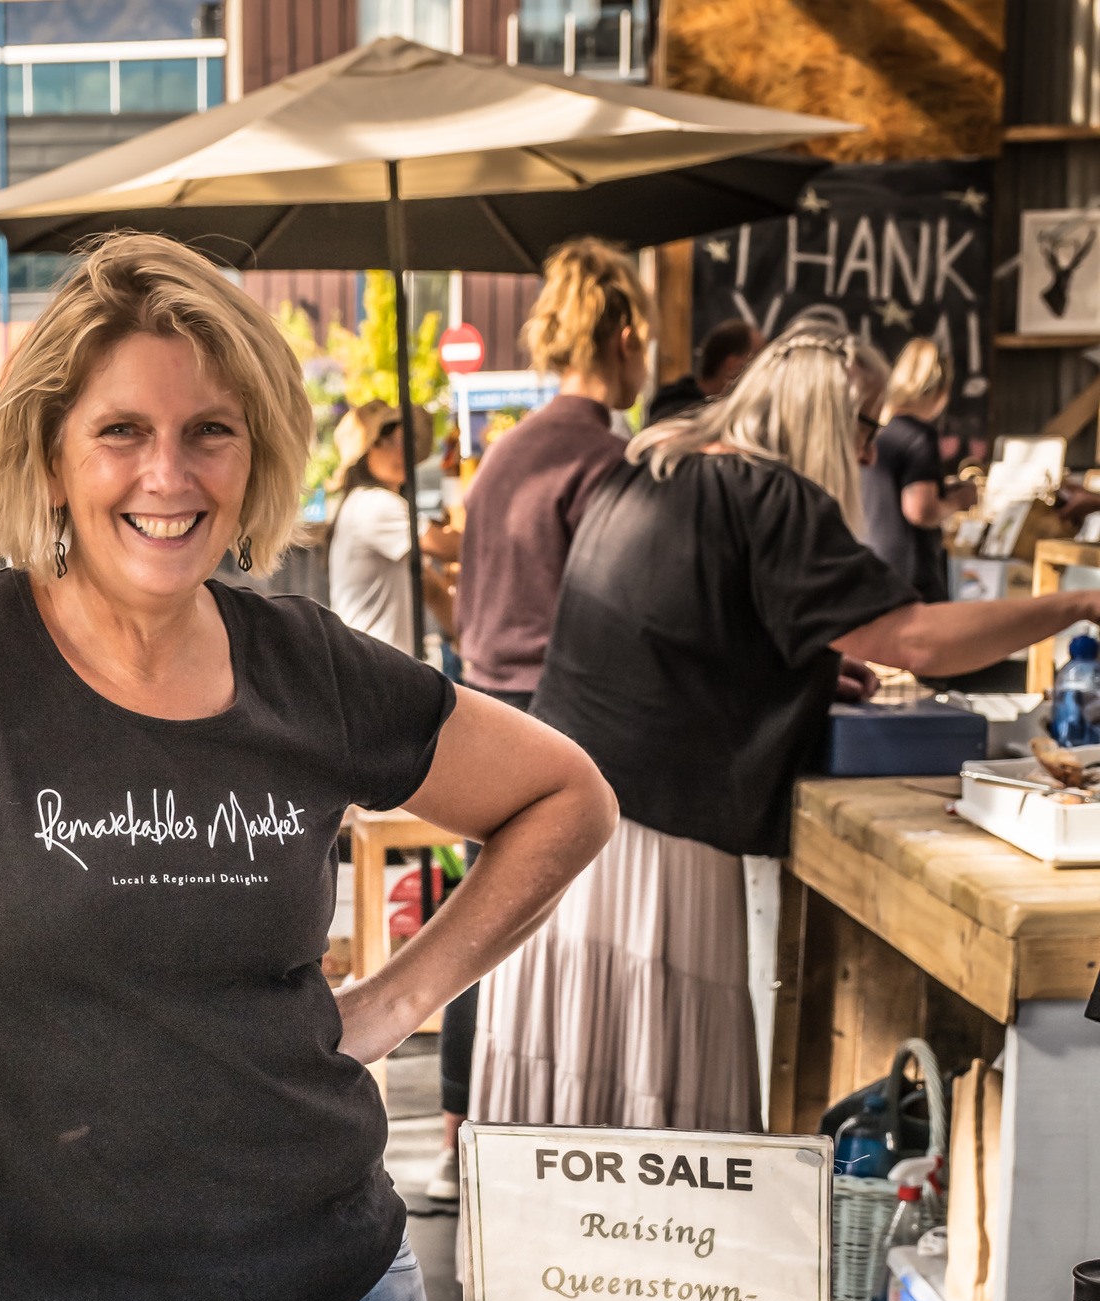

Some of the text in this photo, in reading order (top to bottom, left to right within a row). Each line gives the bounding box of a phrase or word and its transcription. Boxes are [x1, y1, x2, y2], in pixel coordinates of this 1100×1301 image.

[34, 788, 305, 871] Remarkables Market
[112, 874, 269, 886] Local & Regional Delights
[535, 1149, 753, 1192] FOR SALE
[580, 1213, 716, 1258] Raising
